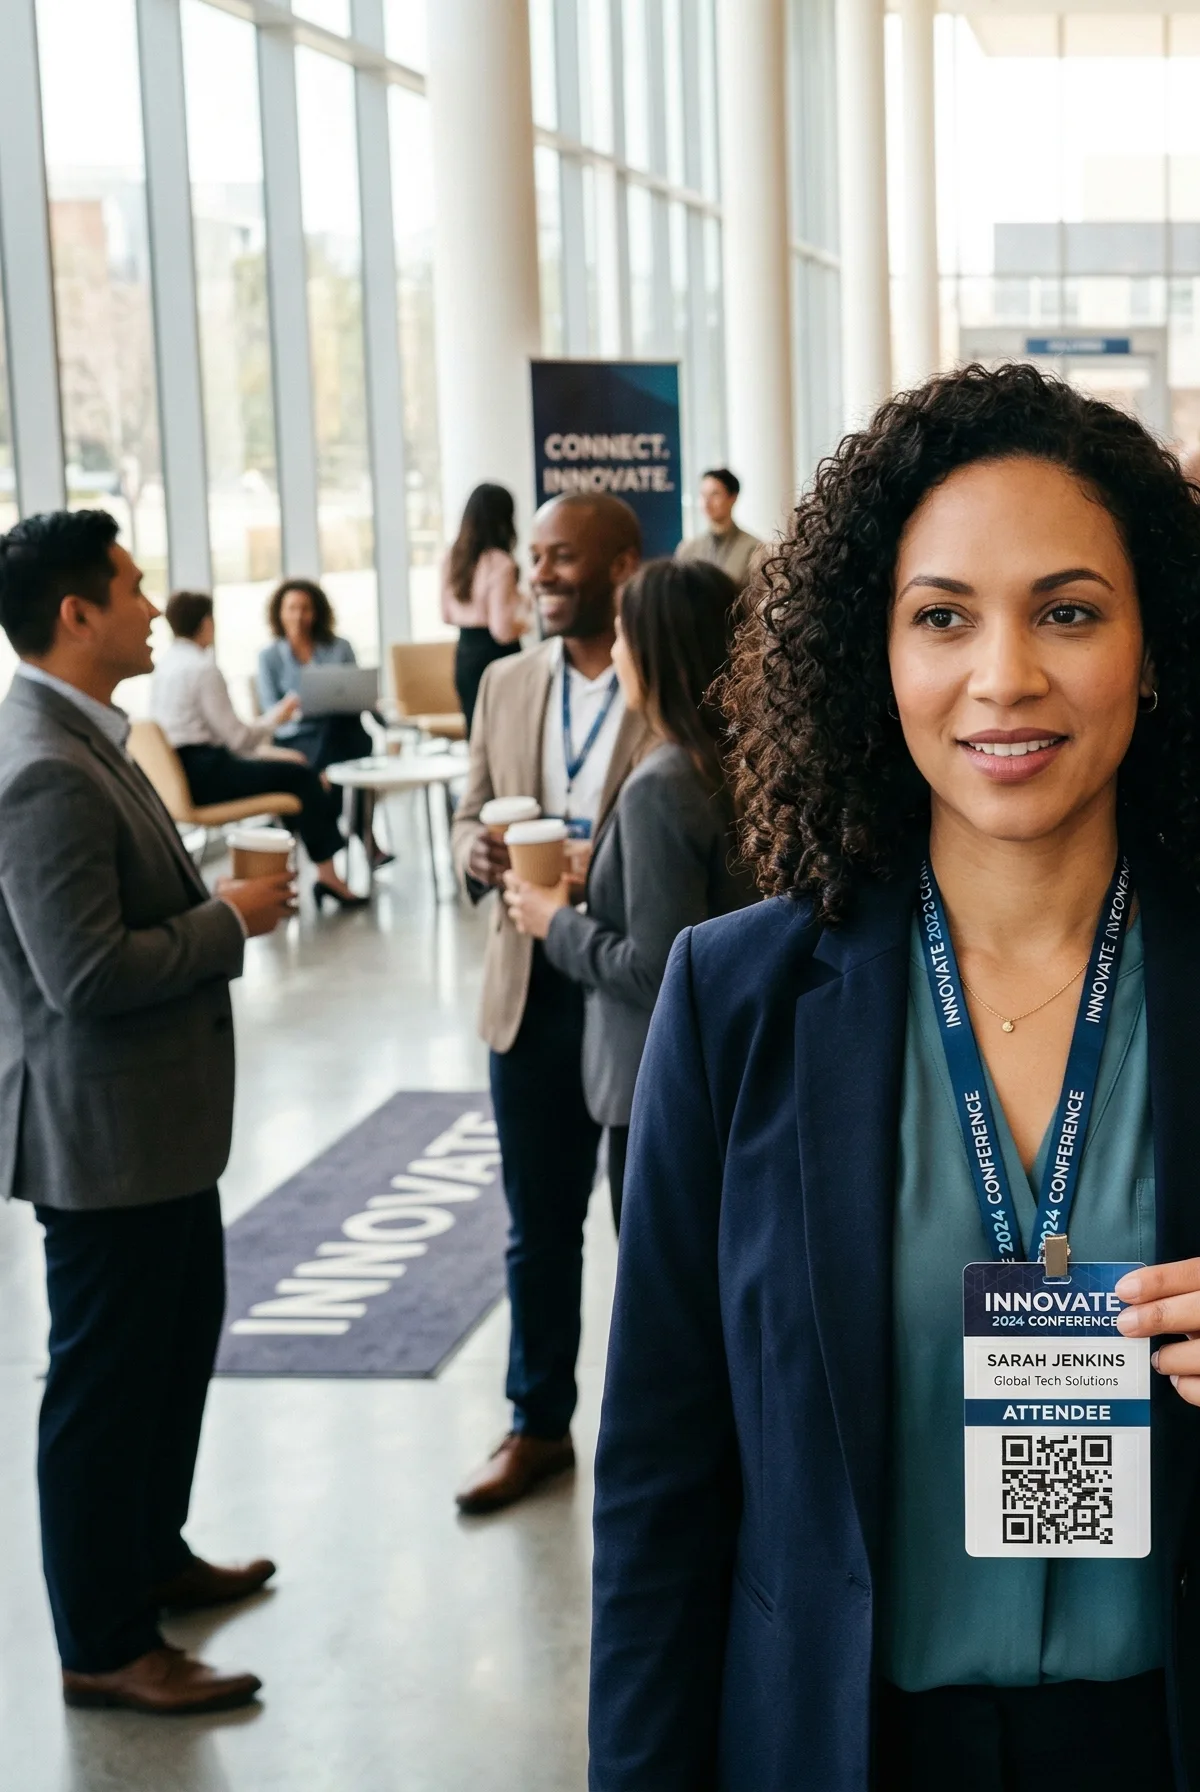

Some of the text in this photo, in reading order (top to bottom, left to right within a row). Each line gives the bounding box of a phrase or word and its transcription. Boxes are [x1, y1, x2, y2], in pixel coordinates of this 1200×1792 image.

[544, 433, 670, 460] CONNECT.
[543, 466, 675, 494] INNOVATE.
[930, 942, 961, 1028] INNOVATE
[1085, 942, 1116, 1023] INNOVATE
[964, 1090, 1003, 1204] CONFERENCE
[1038, 1090, 1084, 1255] 024 CONFERENCE
[991, 1209, 1014, 1254] 2024
[985, 1292, 1121, 1312] INNOVATE
[992, 1316, 1118, 1327] 2024 CONFERENCE
[987, 1353, 1126, 1367] SARAH JENKINS
[994, 1375, 1119, 1386] Global Tech Solutions
[1003, 1404, 1111, 1421] ATTENDEE
